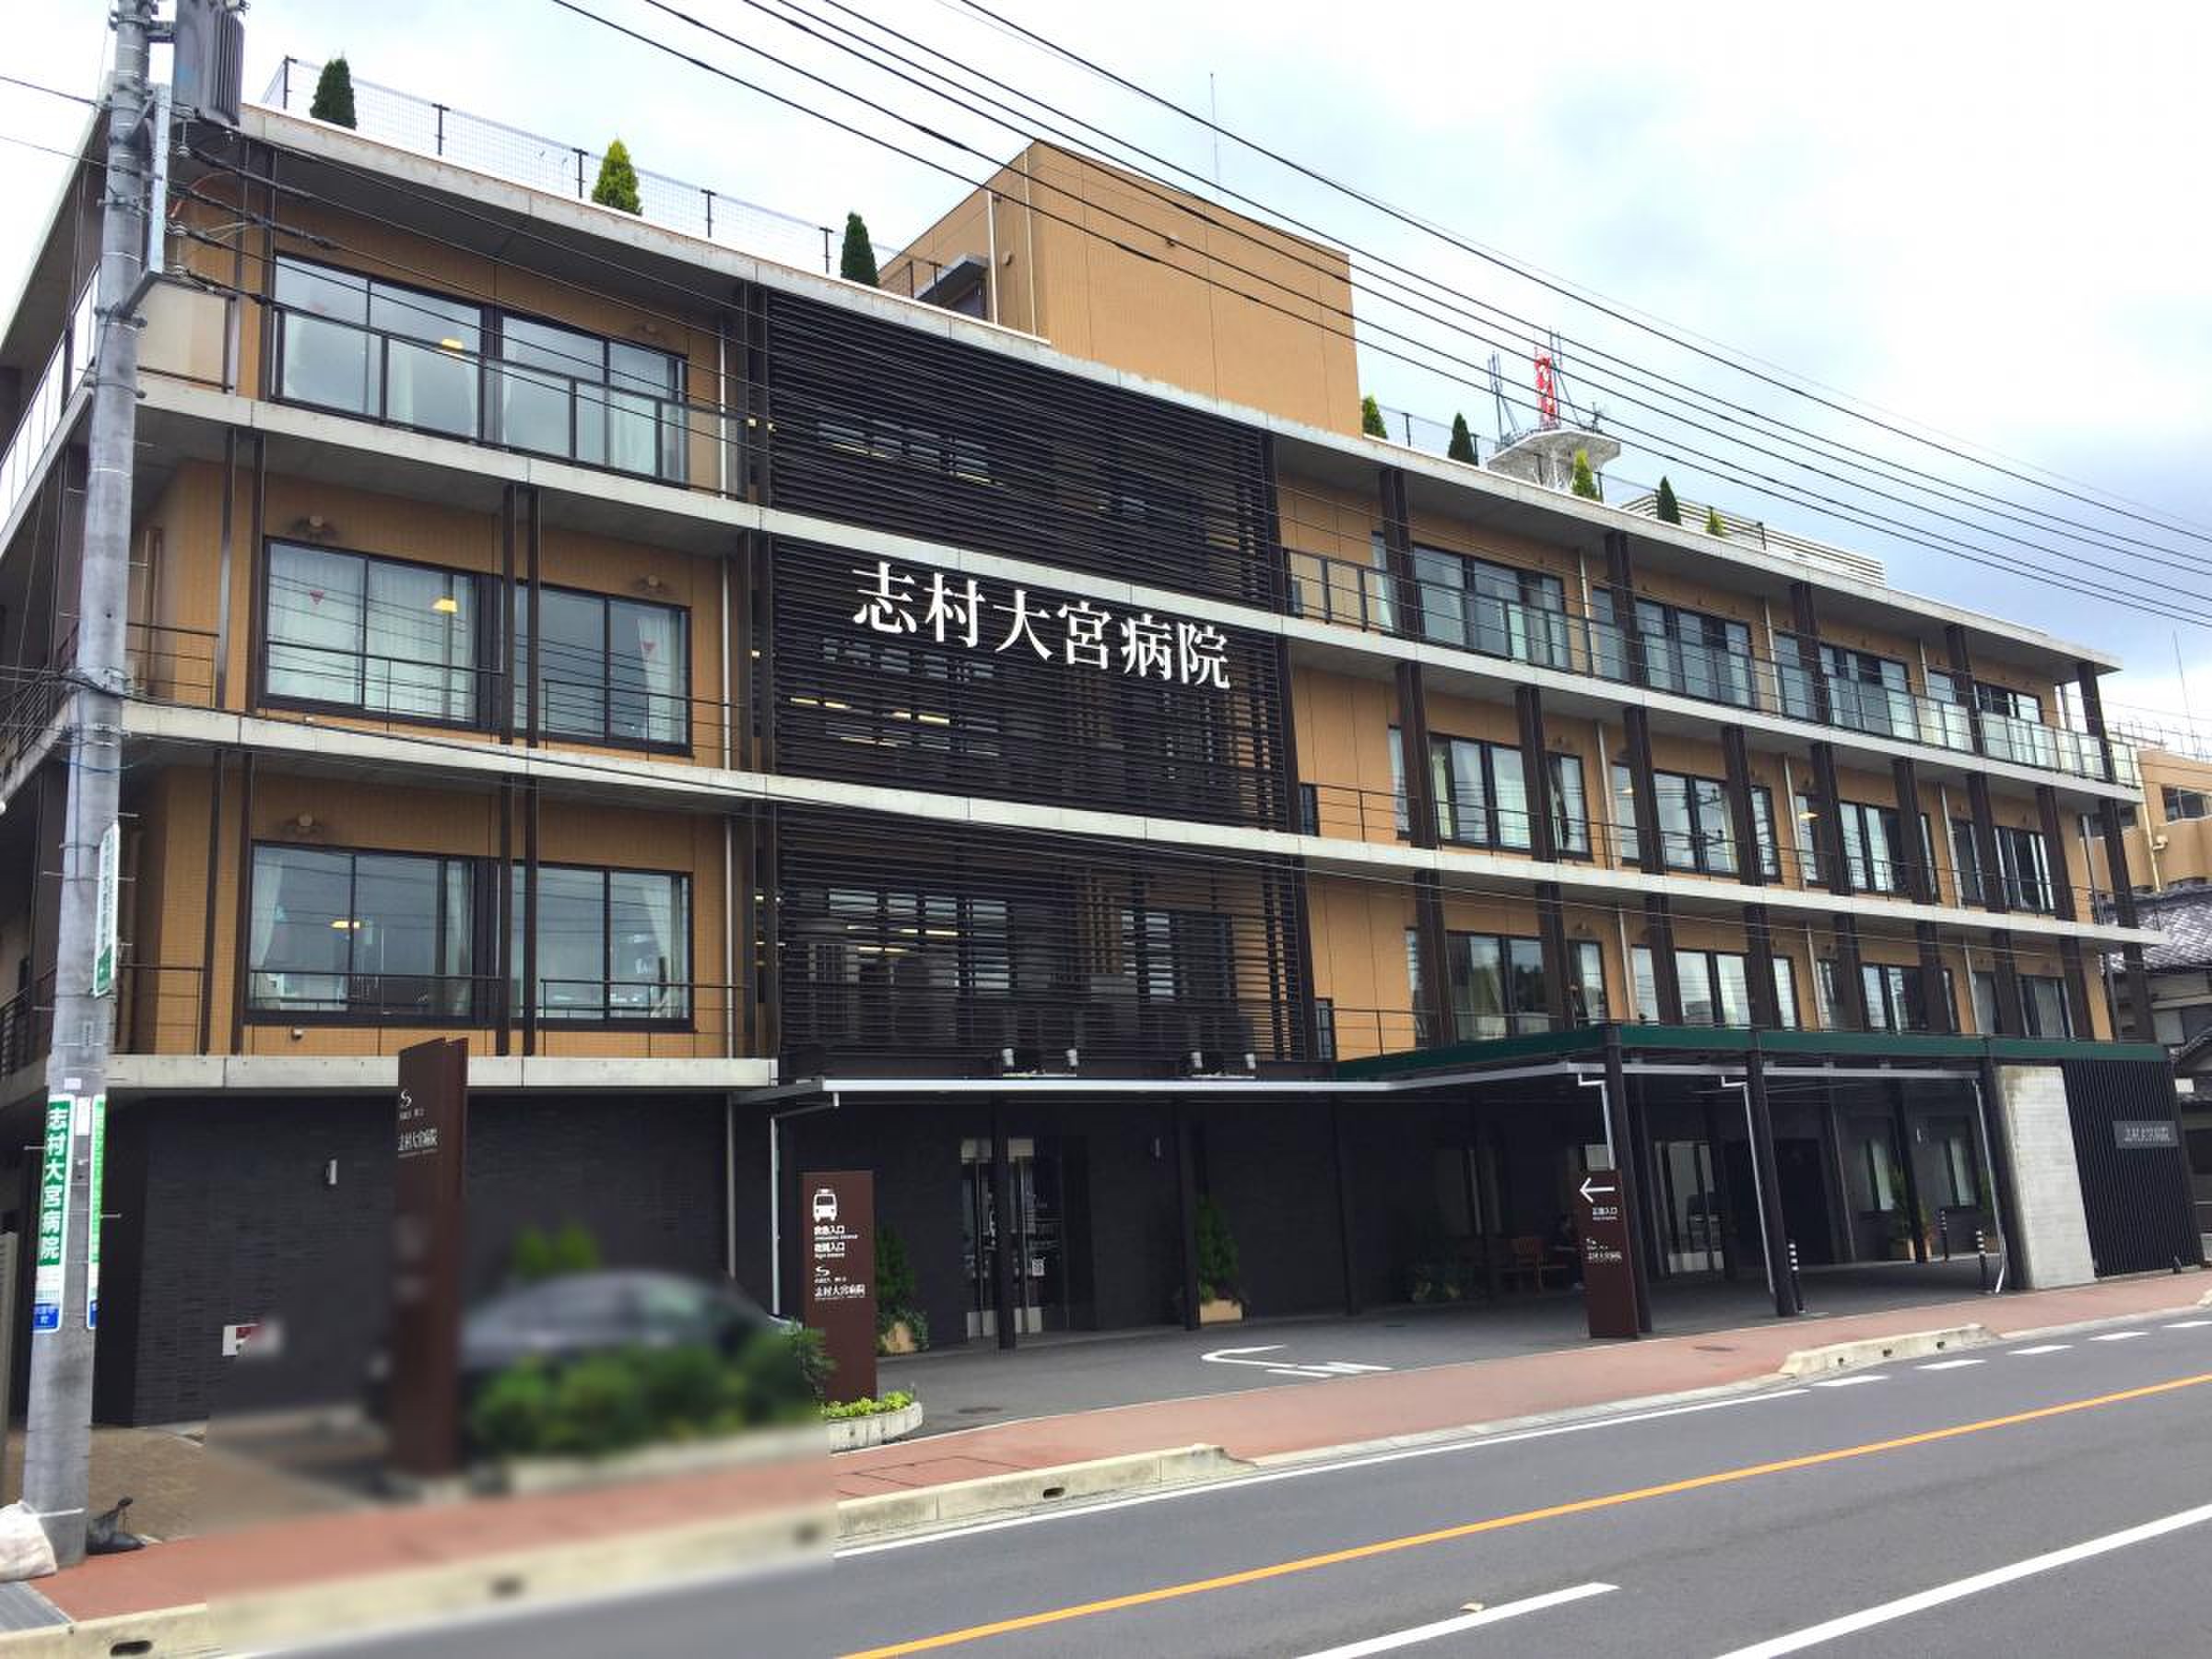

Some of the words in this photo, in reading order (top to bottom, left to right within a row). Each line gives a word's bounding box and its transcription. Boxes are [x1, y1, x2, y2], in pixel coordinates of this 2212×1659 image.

[852, 560, 1231, 690] 志村大宮病院
[40, 1108, 68, 1260] 志村大宮病院
